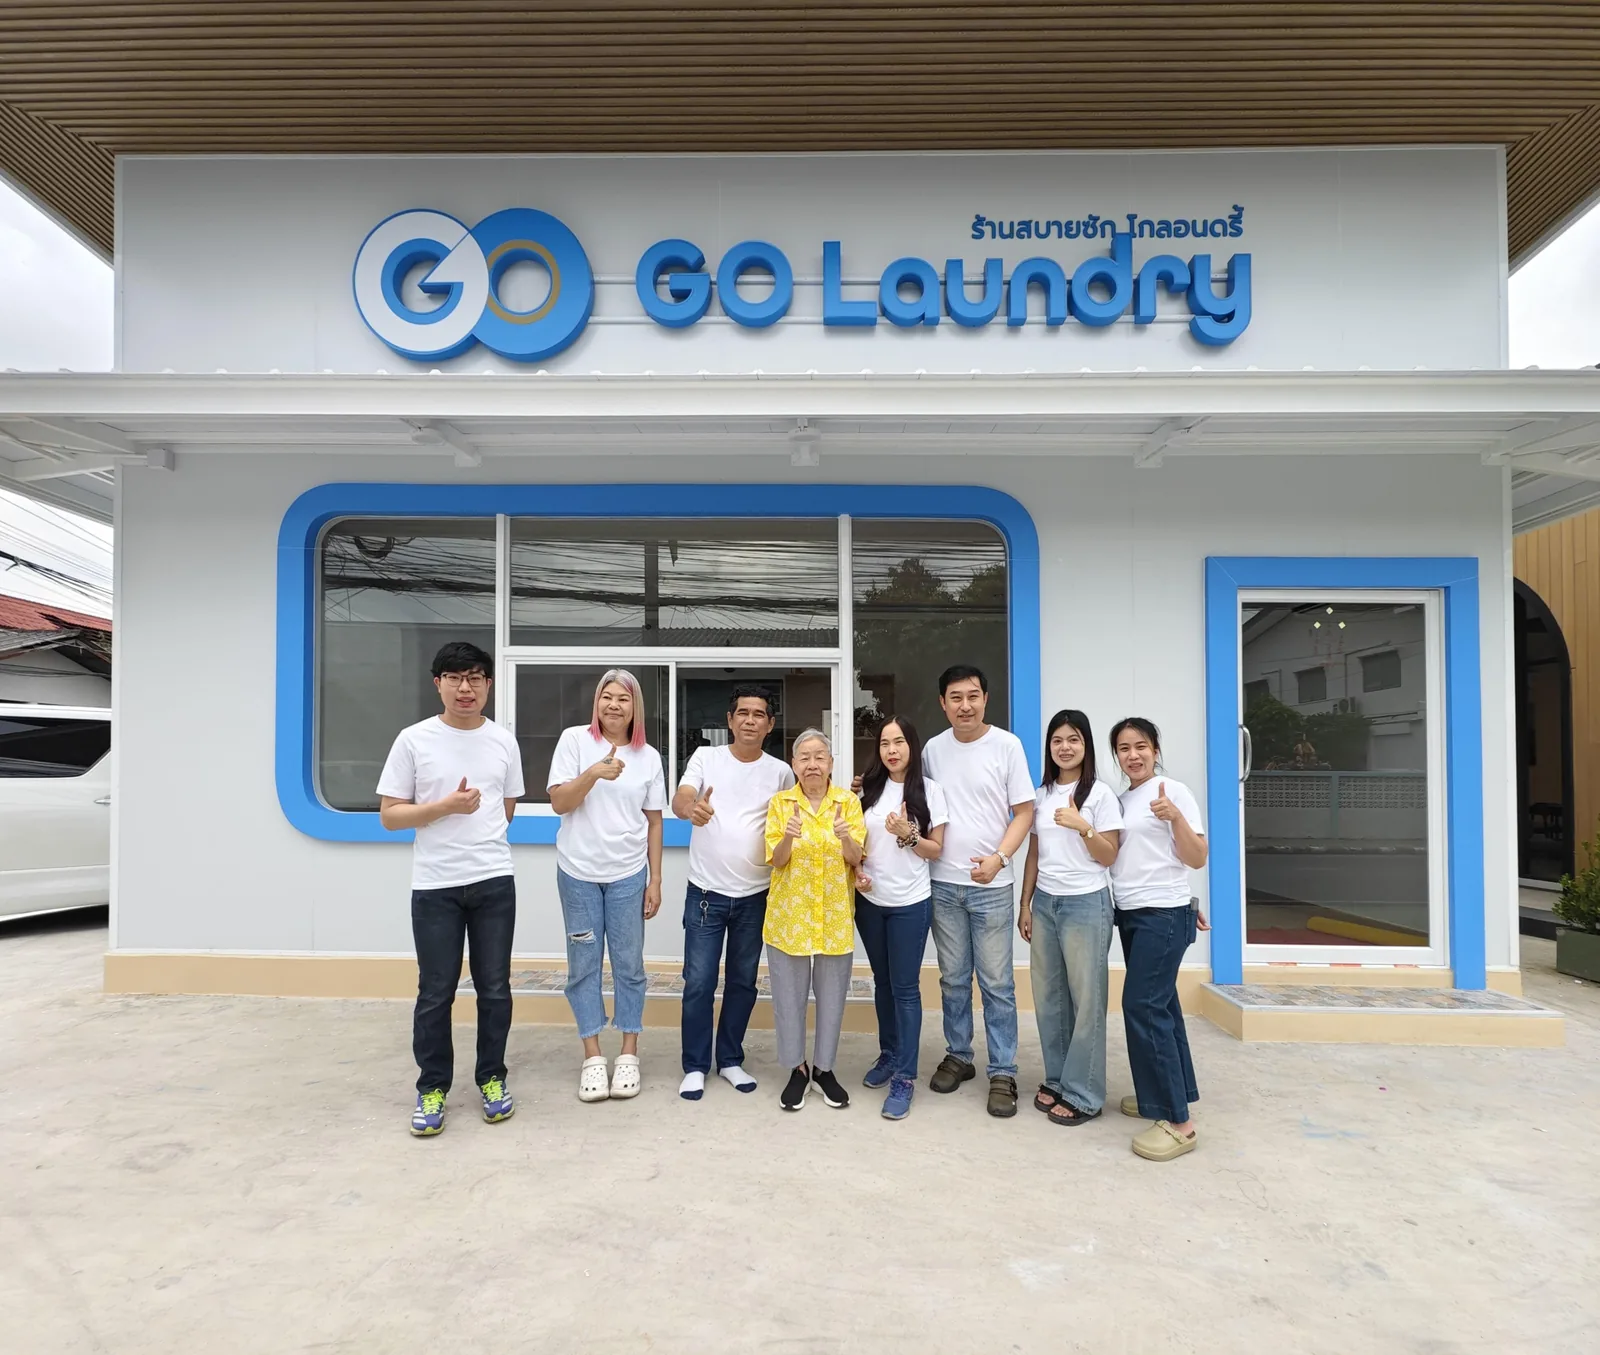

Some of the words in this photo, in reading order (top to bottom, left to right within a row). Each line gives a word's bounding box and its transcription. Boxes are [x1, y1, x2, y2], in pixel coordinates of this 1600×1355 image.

[971, 213, 1116, 239] ร้านสบายซัก
[353, 208, 593, 361] GO
[636, 239, 793, 328] GO
[822, 232, 1252, 346] Laundry
